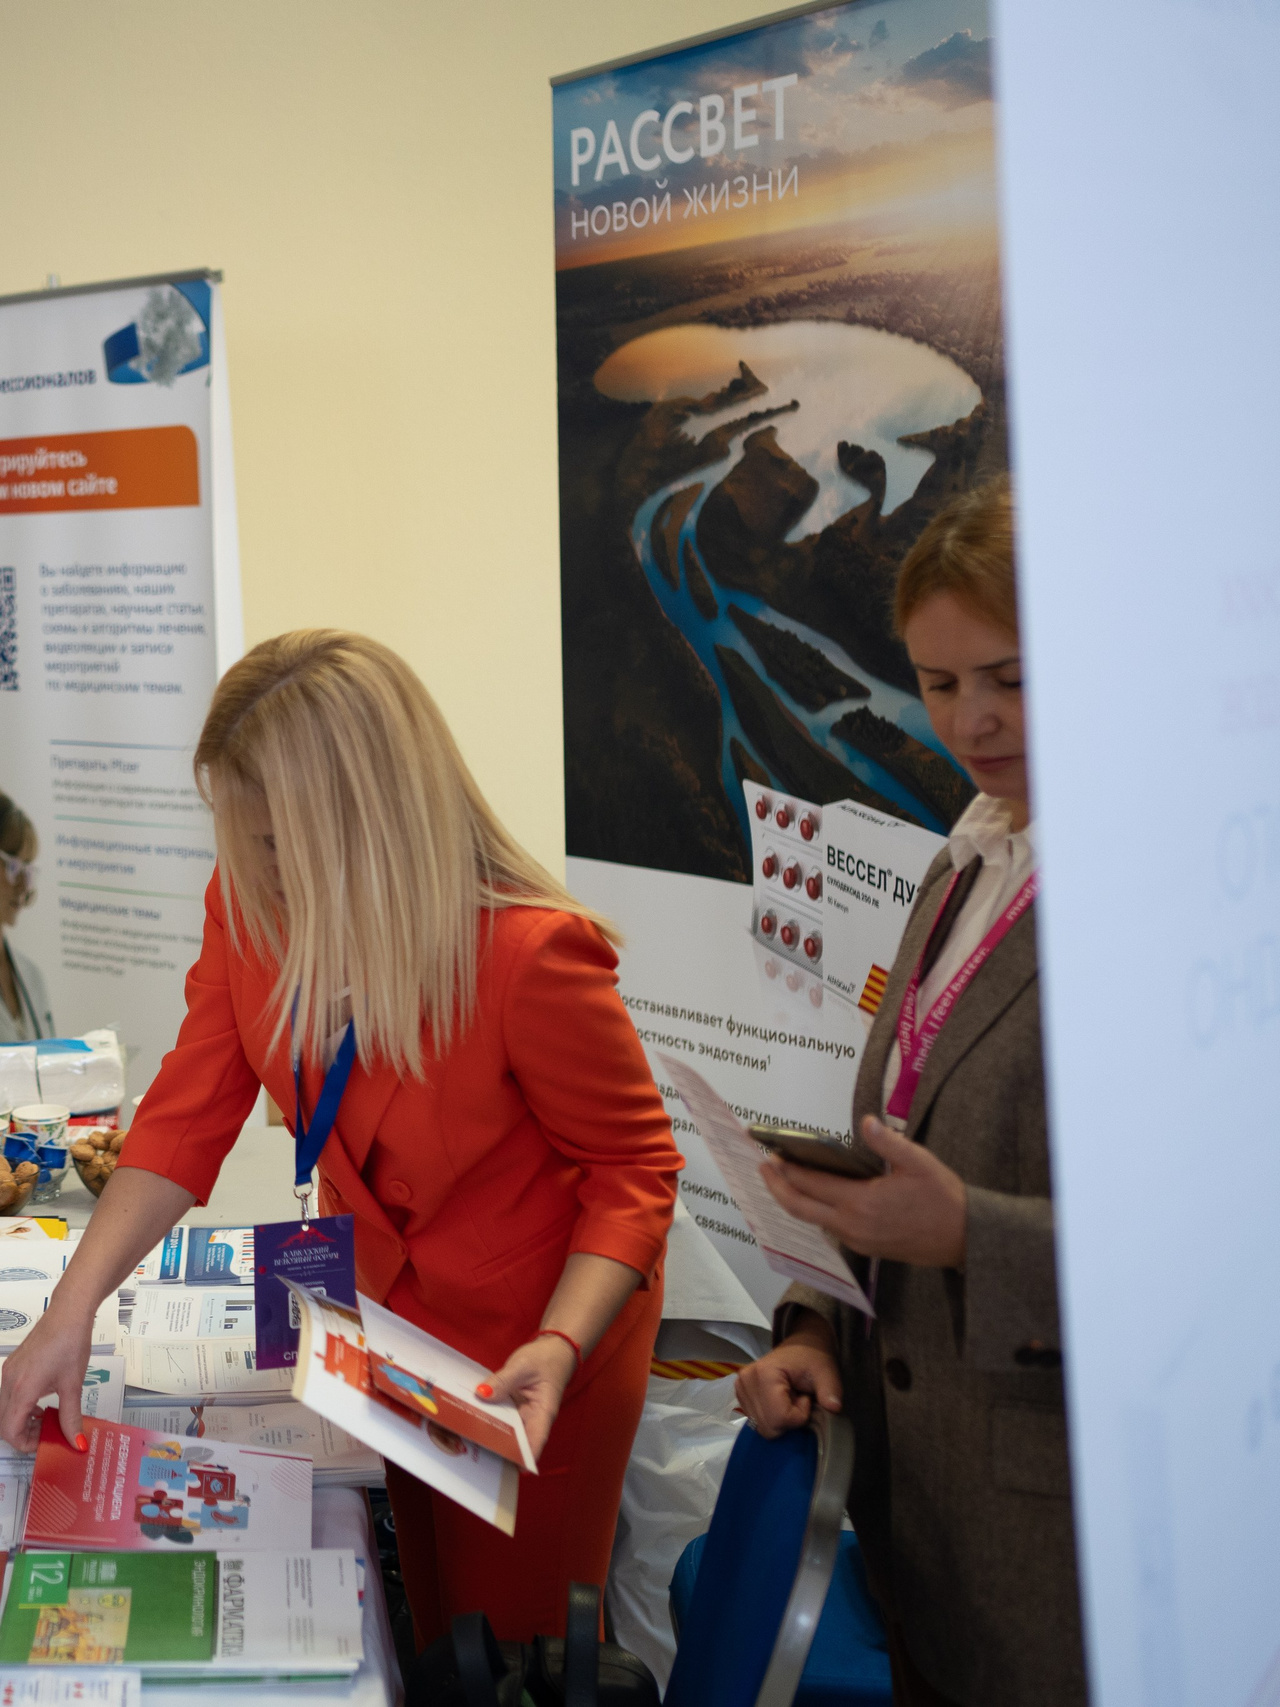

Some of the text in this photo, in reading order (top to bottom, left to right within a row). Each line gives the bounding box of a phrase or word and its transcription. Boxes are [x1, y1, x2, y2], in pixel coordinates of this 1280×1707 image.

[570, 73, 798, 187] РАССВЕТ
[571, 165, 799, 240] НОВОЙ ЖИЗНИ
[12, 480, 65, 500] новом
[67, 473, 118, 496] сайте
[893, 876, 921, 907] ДУ
[621, 996, 856, 1059] осстанавливает функциональную
[637, 1029, 695, 1053] остность
[681, 1178, 729, 1207] снизить
[695, 1214, 758, 1246] связанных
[283, 1350, 299, 1361] СП
[111, 1434, 131, 1521] ДНЕВНИК ПАЦИЕНТА
[30, 1560, 64, 1584] 12
[222, 1574, 245, 1657] ФАРМАТЕКА
